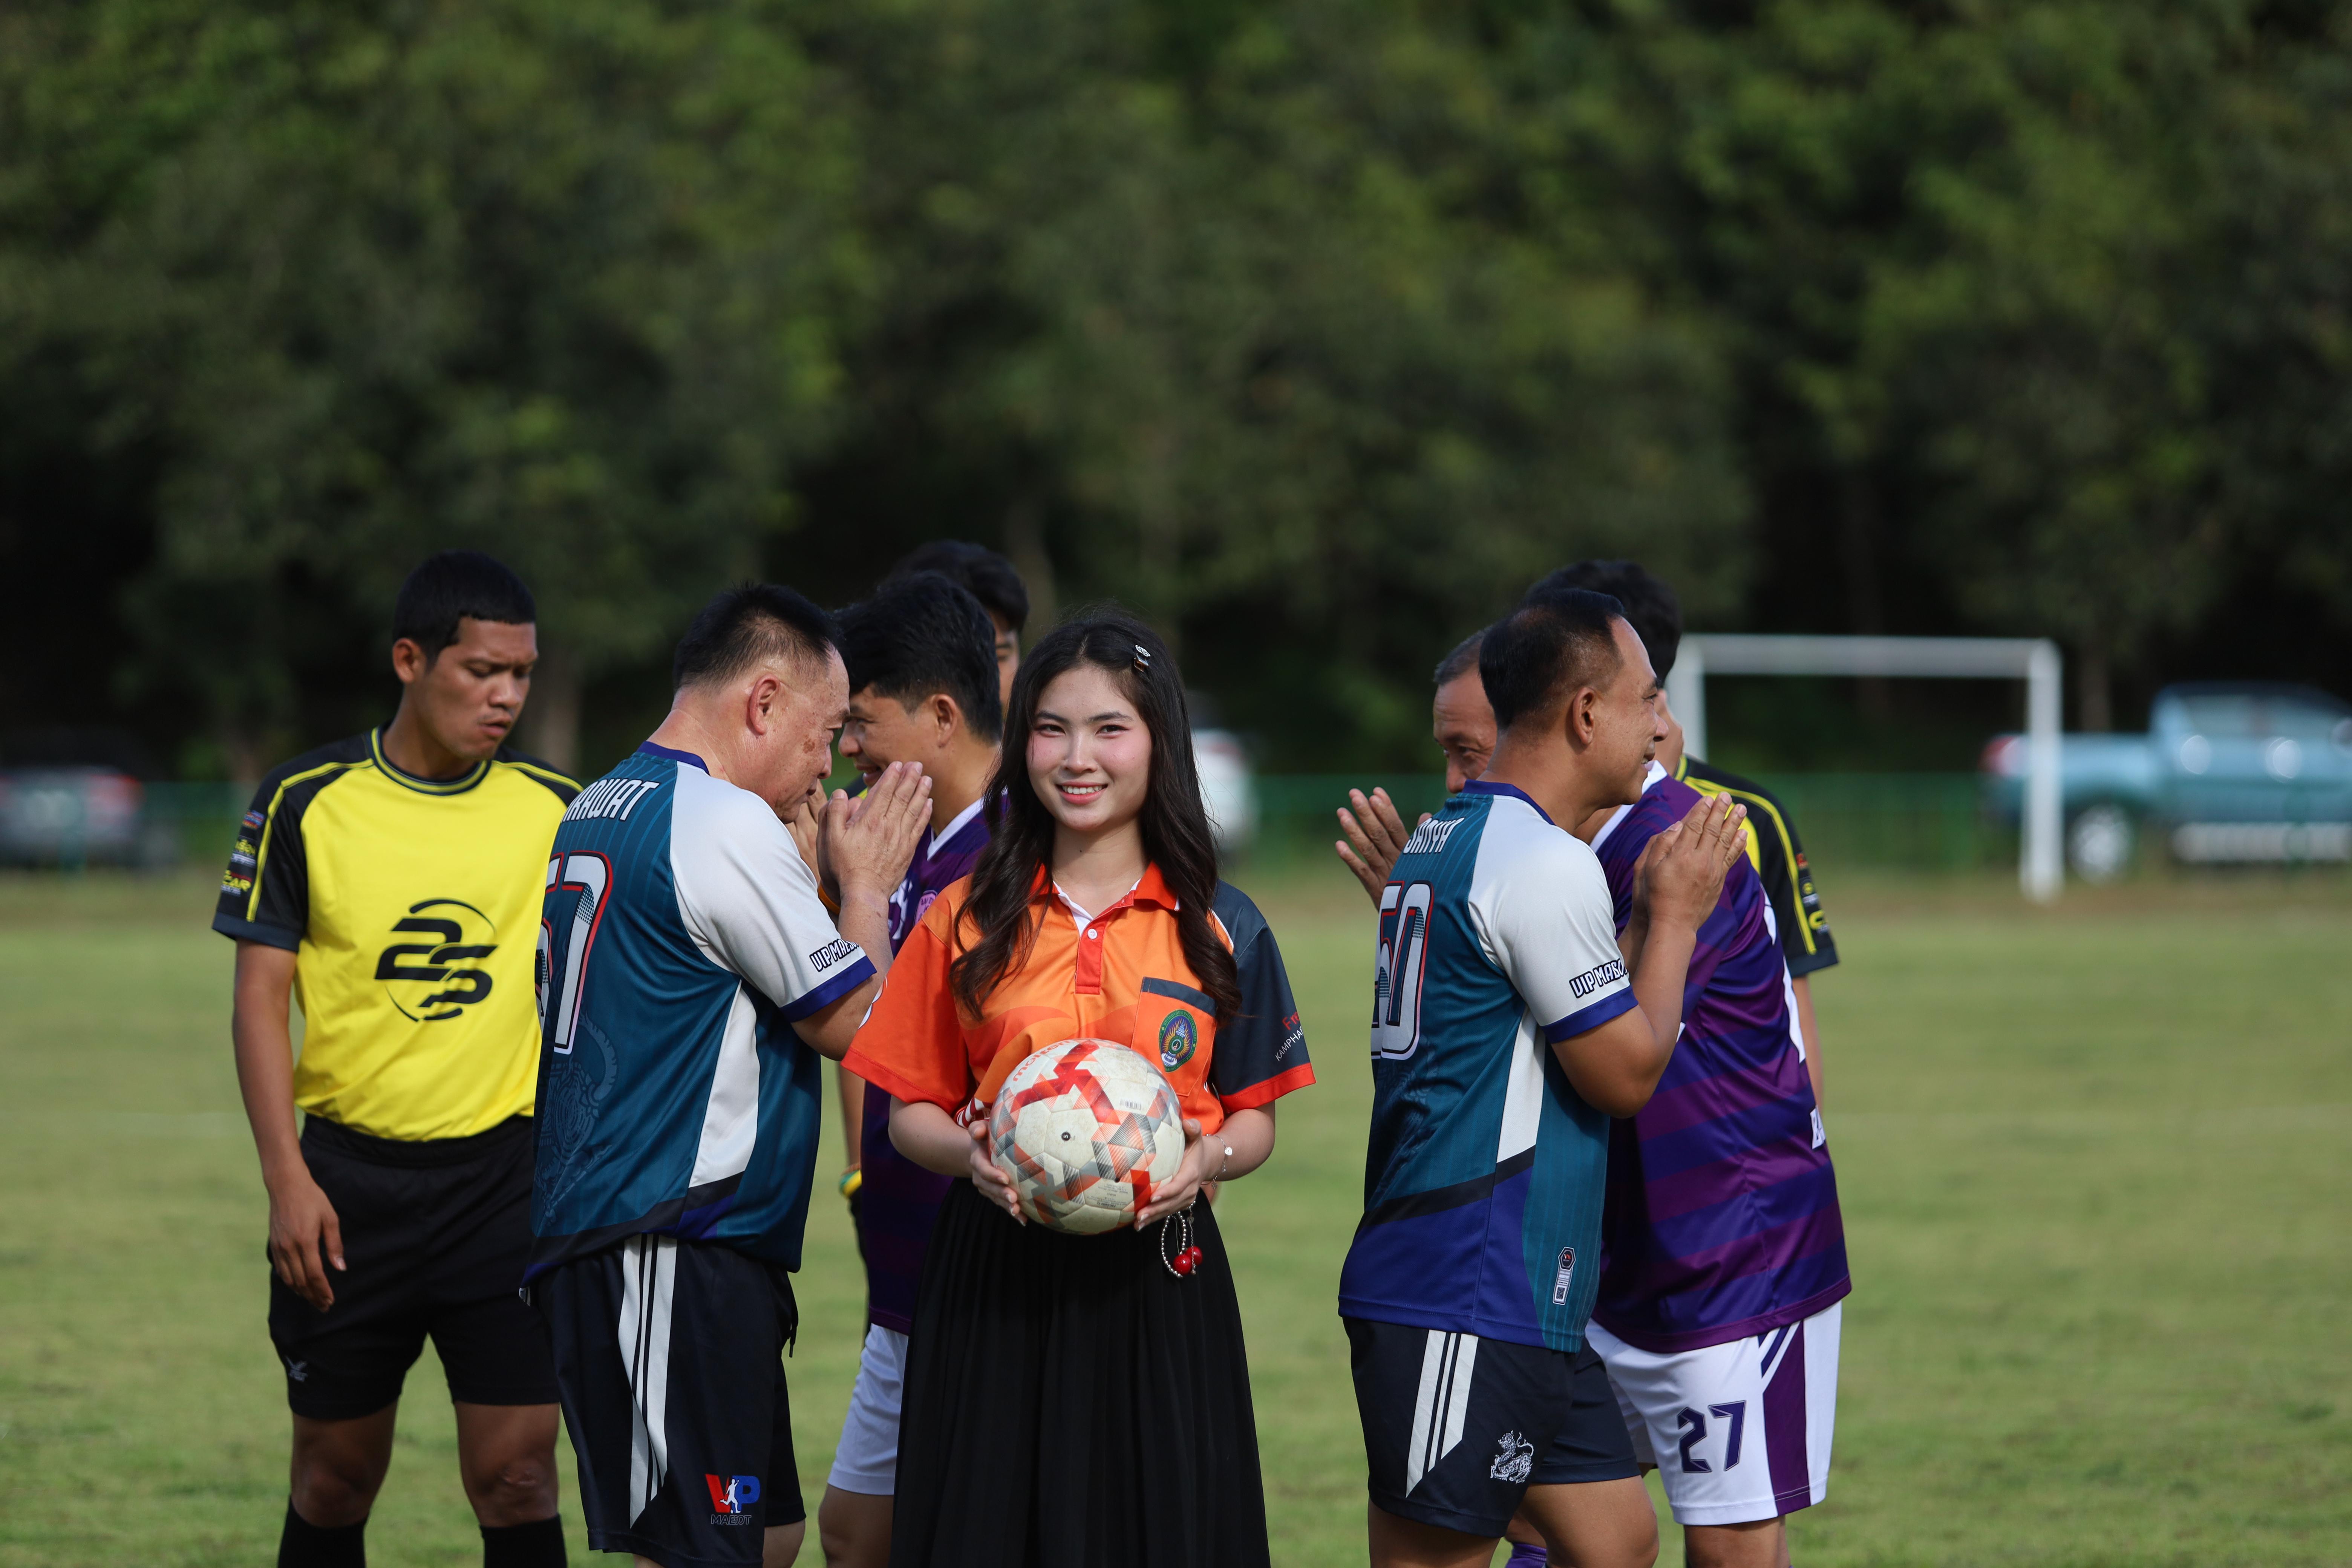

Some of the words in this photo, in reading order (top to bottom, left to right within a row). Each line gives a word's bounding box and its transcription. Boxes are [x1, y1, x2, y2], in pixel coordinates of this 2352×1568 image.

[1370, 880, 1434, 1060] 50
[1677, 1400, 1747, 1473] 27
[710, 1514, 752, 1525] MAESOT
